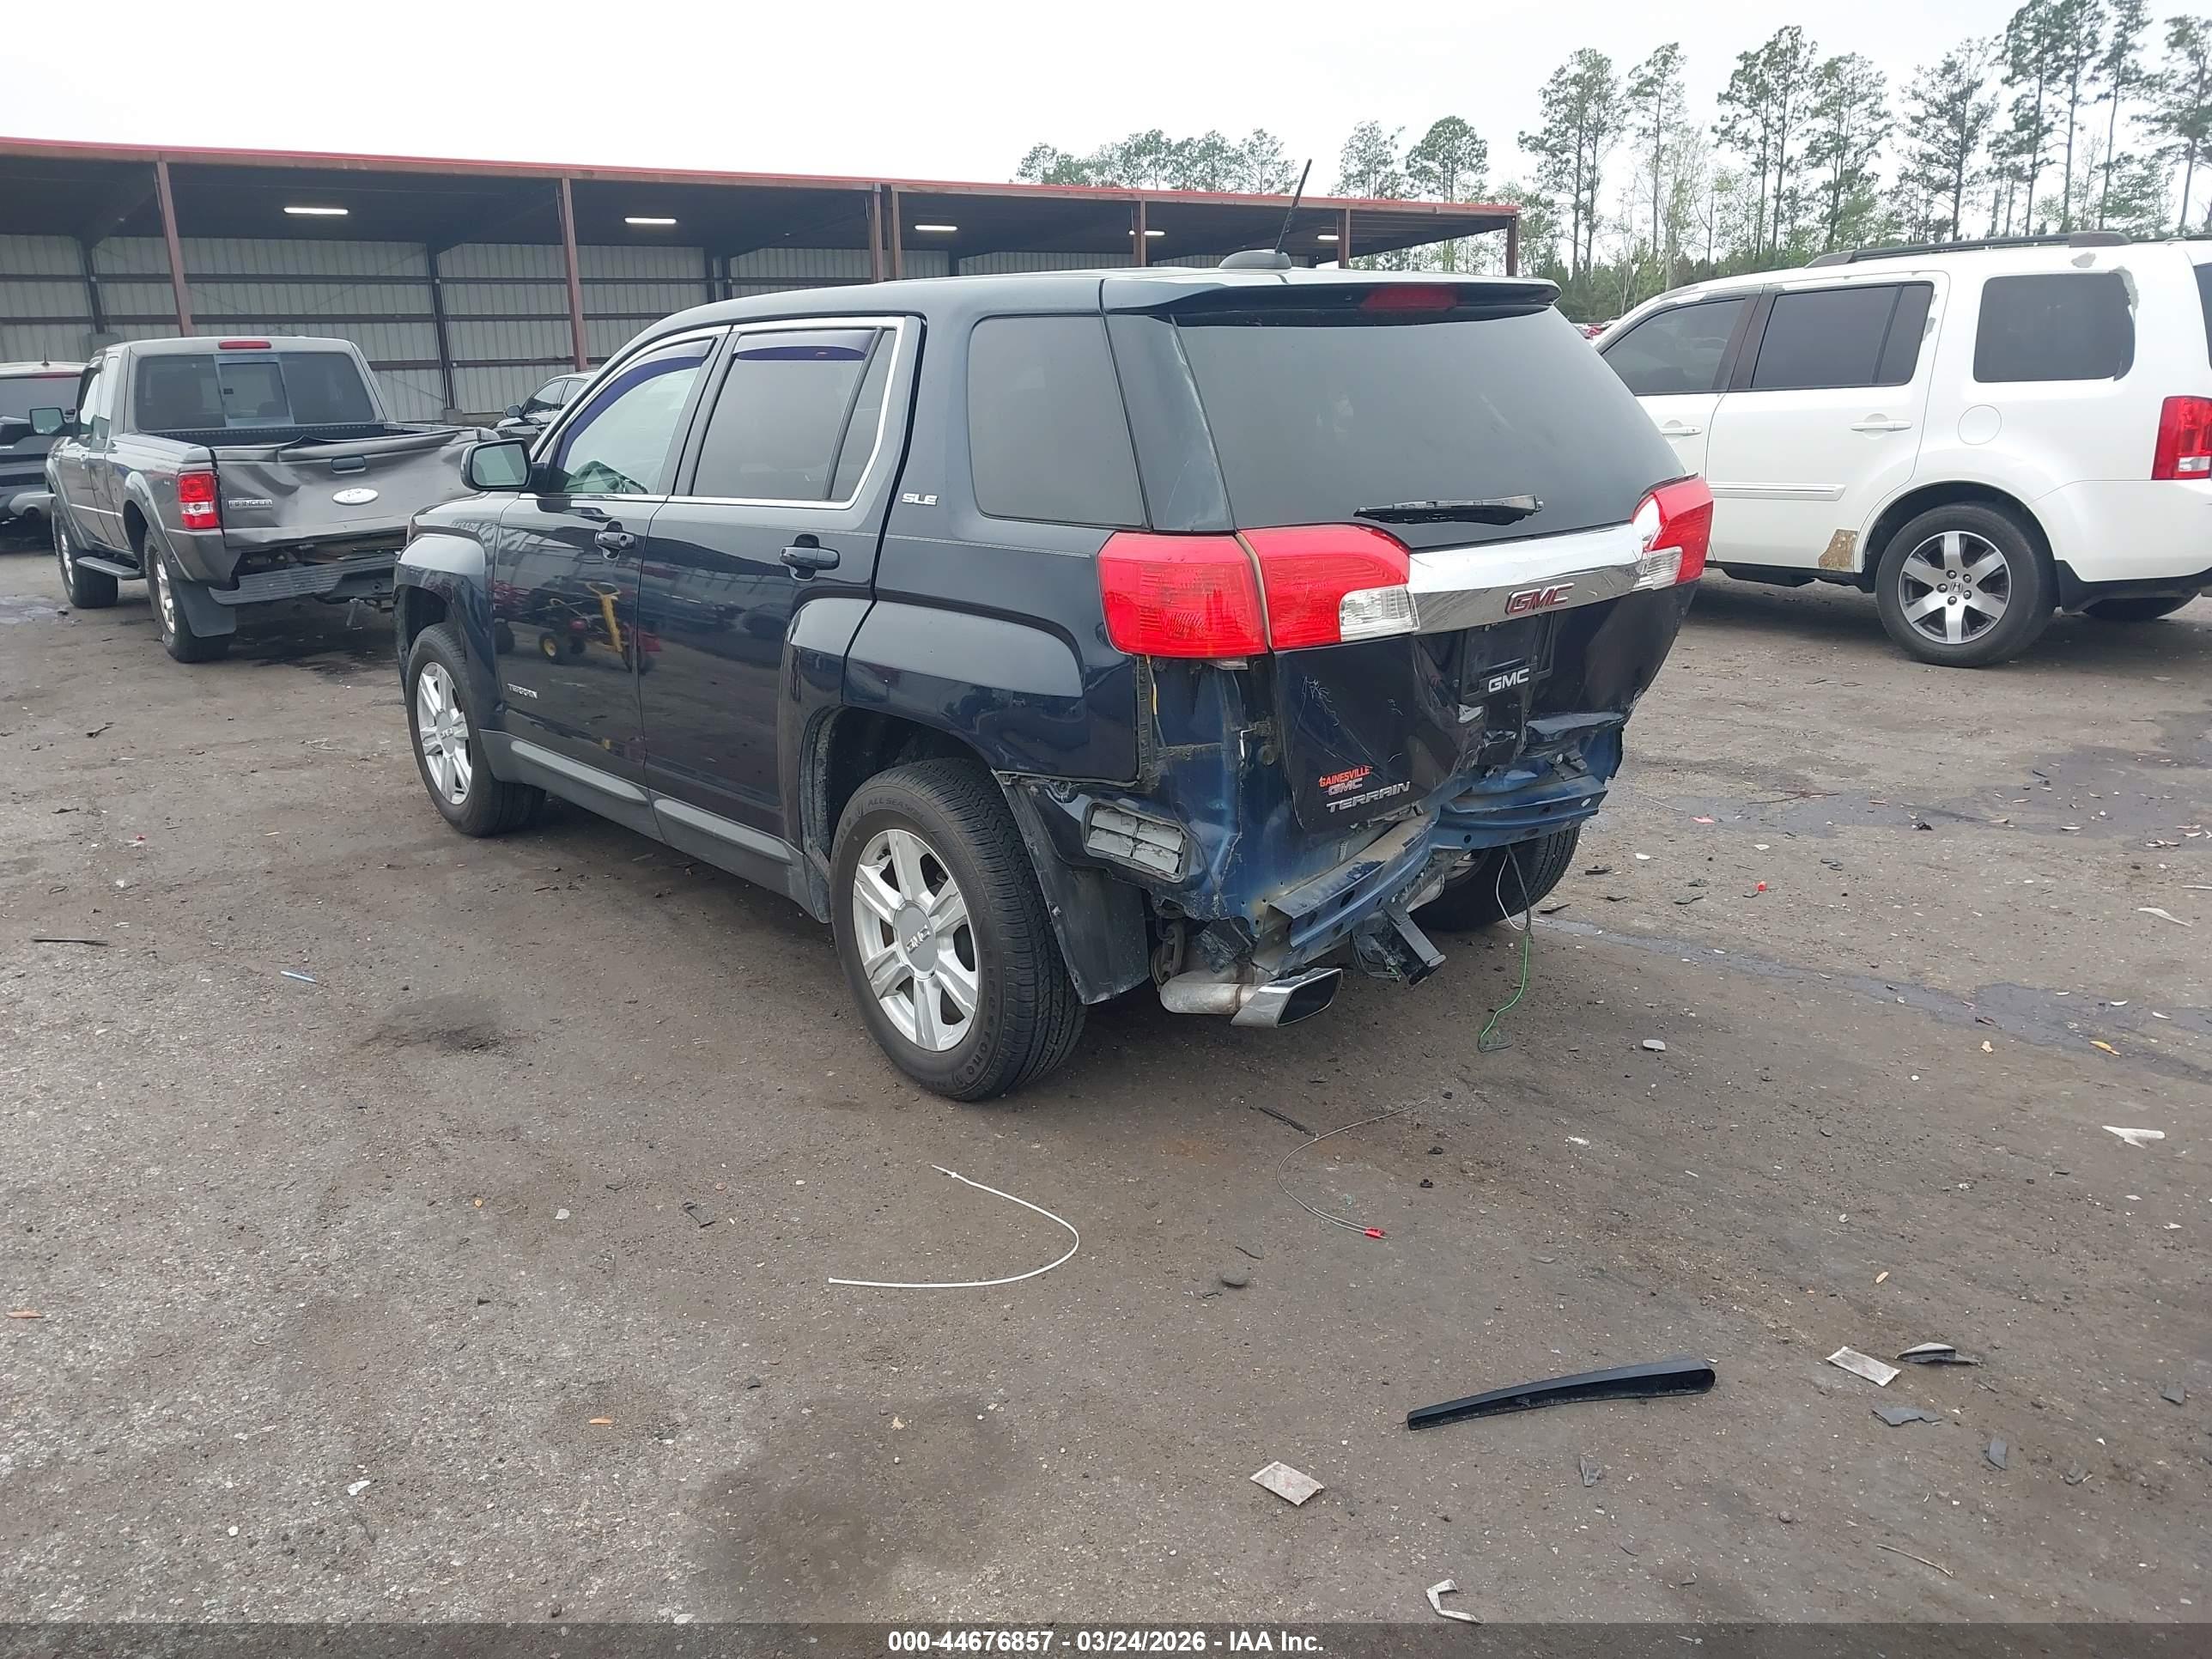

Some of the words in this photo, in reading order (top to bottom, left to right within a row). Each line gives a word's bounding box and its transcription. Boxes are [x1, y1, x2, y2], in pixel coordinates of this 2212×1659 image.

[902, 493, 939, 506] SLE
[1504, 583, 1575, 615] GMC
[1488, 668, 1530, 693] GMC
[1318, 765, 1371, 787] GAINESVILLE
[1328, 777, 1364, 796] GMC
[1326, 781, 1411, 813] TERRAIN
